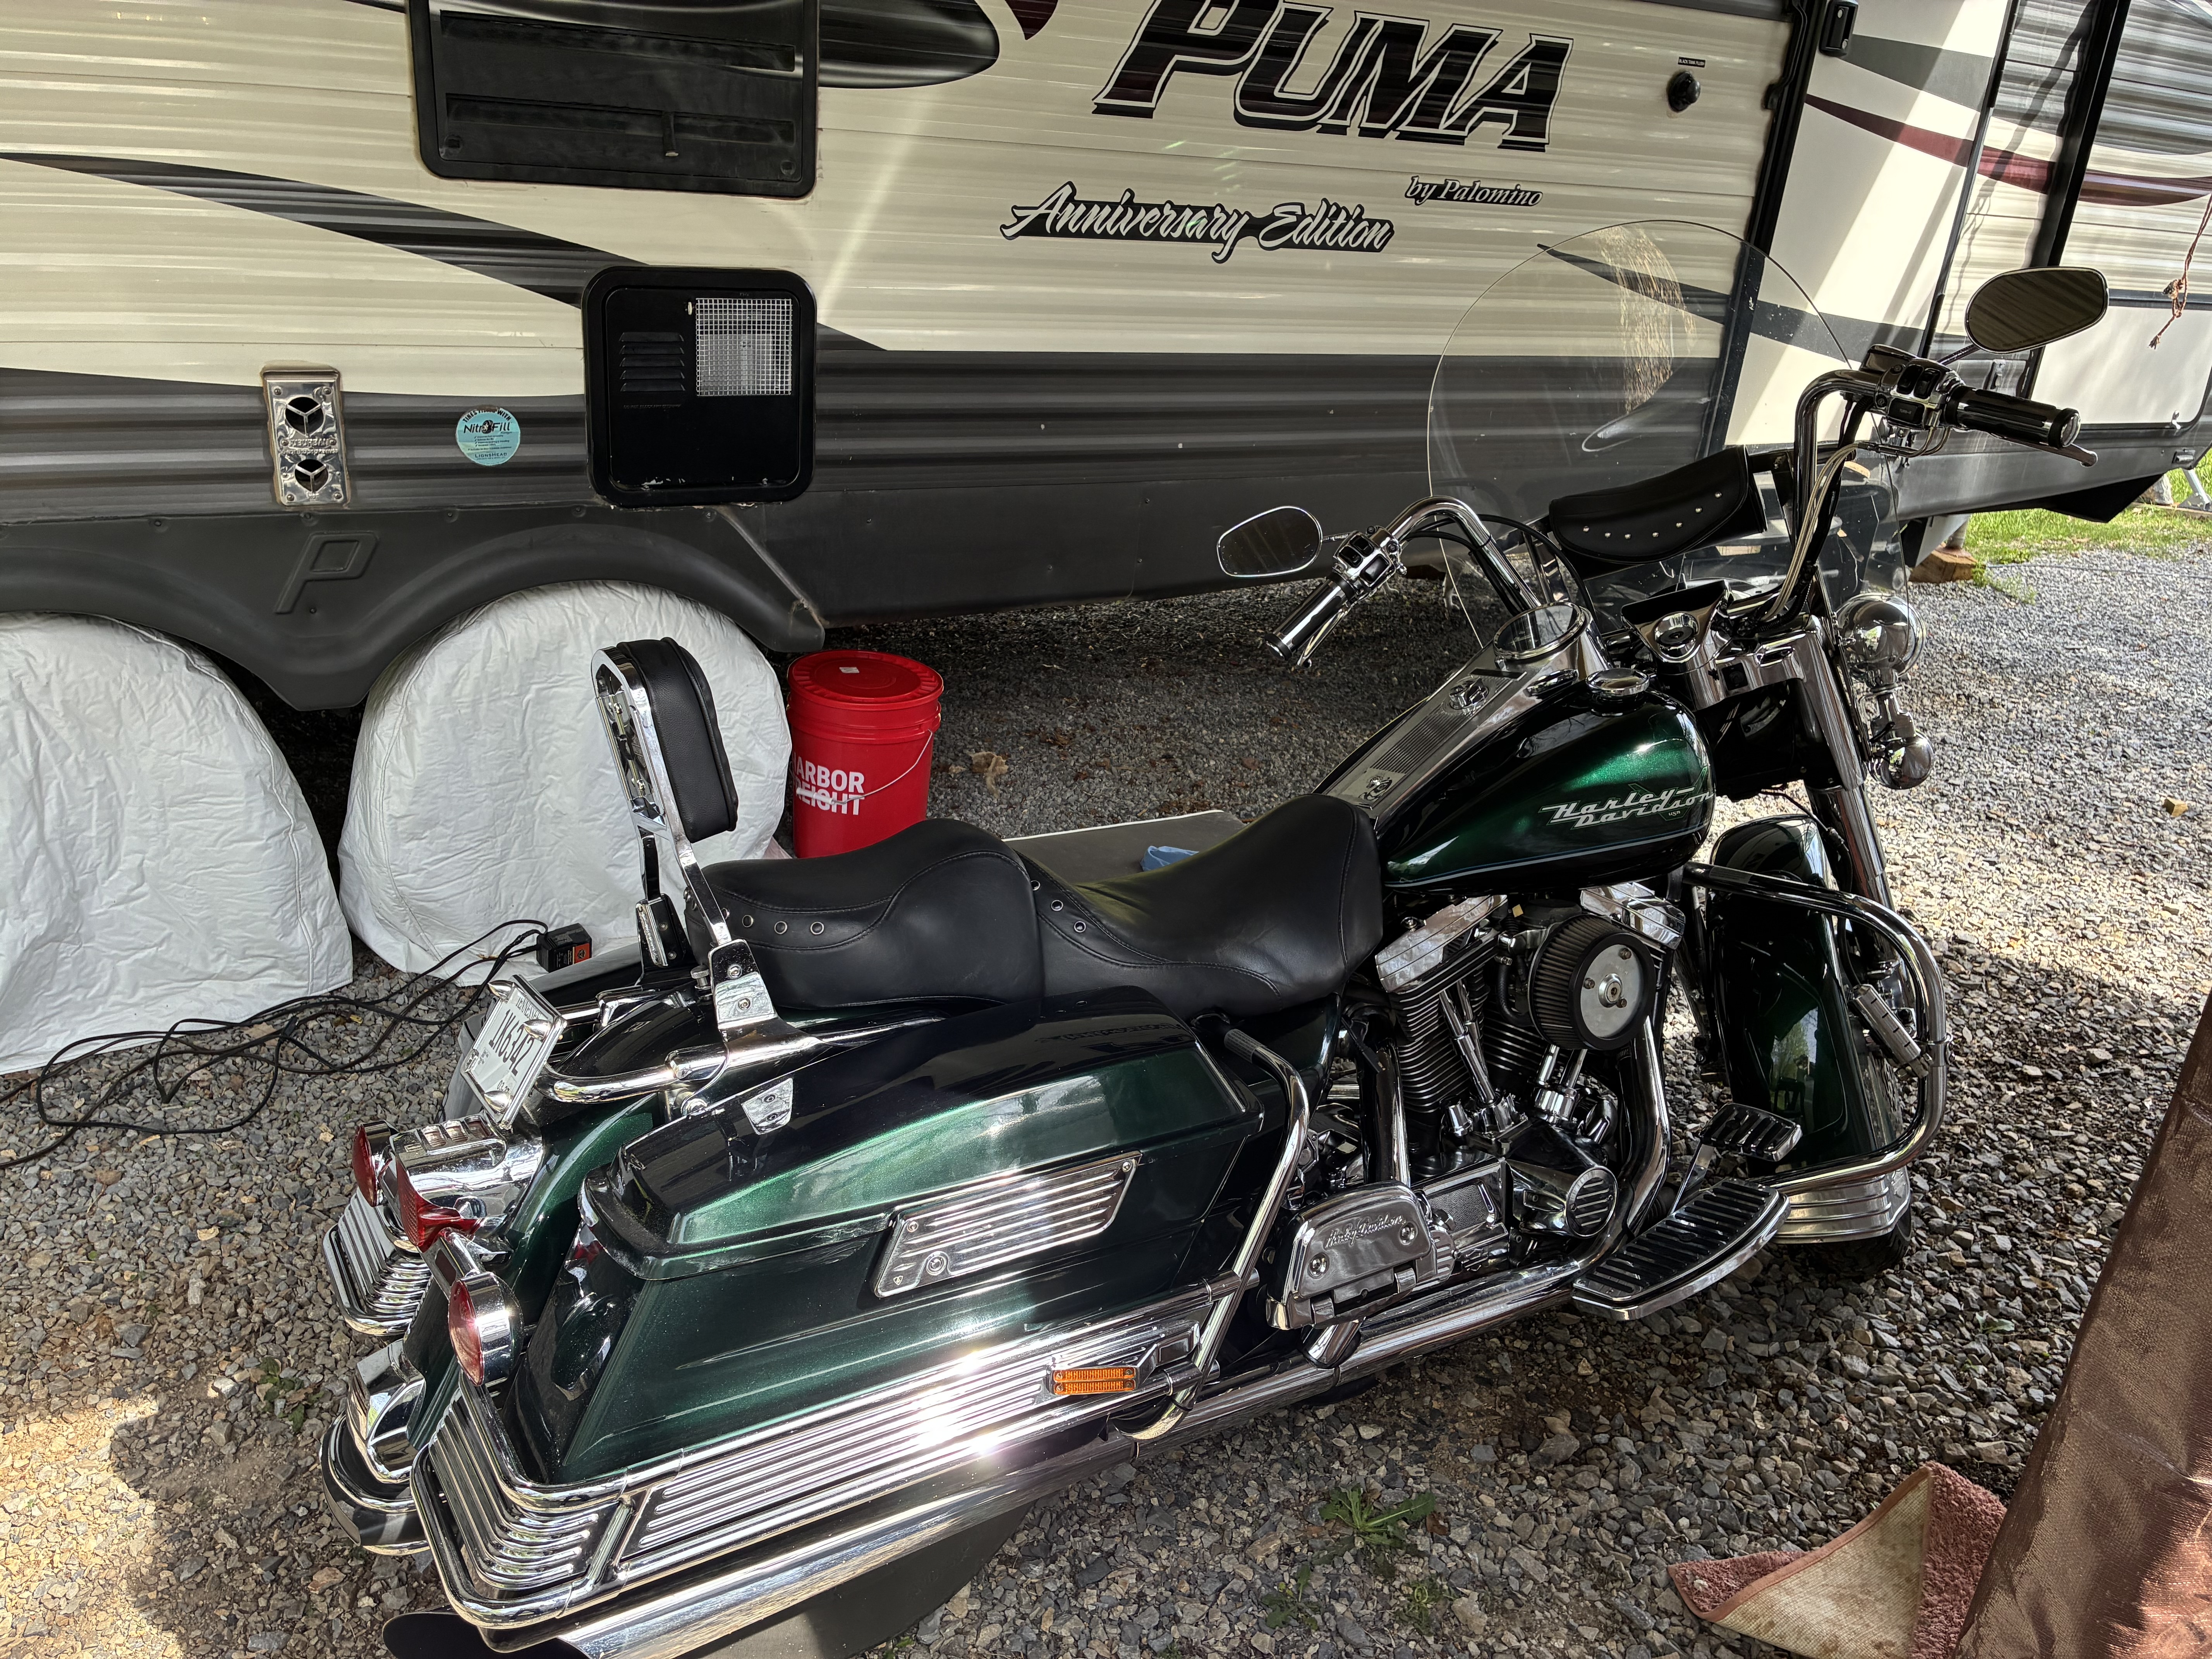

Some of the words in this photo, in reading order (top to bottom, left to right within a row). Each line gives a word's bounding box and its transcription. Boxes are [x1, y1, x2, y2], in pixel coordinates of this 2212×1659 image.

[1092, 0, 1574, 152] PUMA
[1406, 176, 1437, 205] by
[1437, 180, 1543, 206] Palomino
[1001, 183, 1249, 261] Anniversary
[1258, 199, 1393, 251] Edition
[497, 409, 512, 421] WITH
[1550, 792, 1714, 828] Davidson
